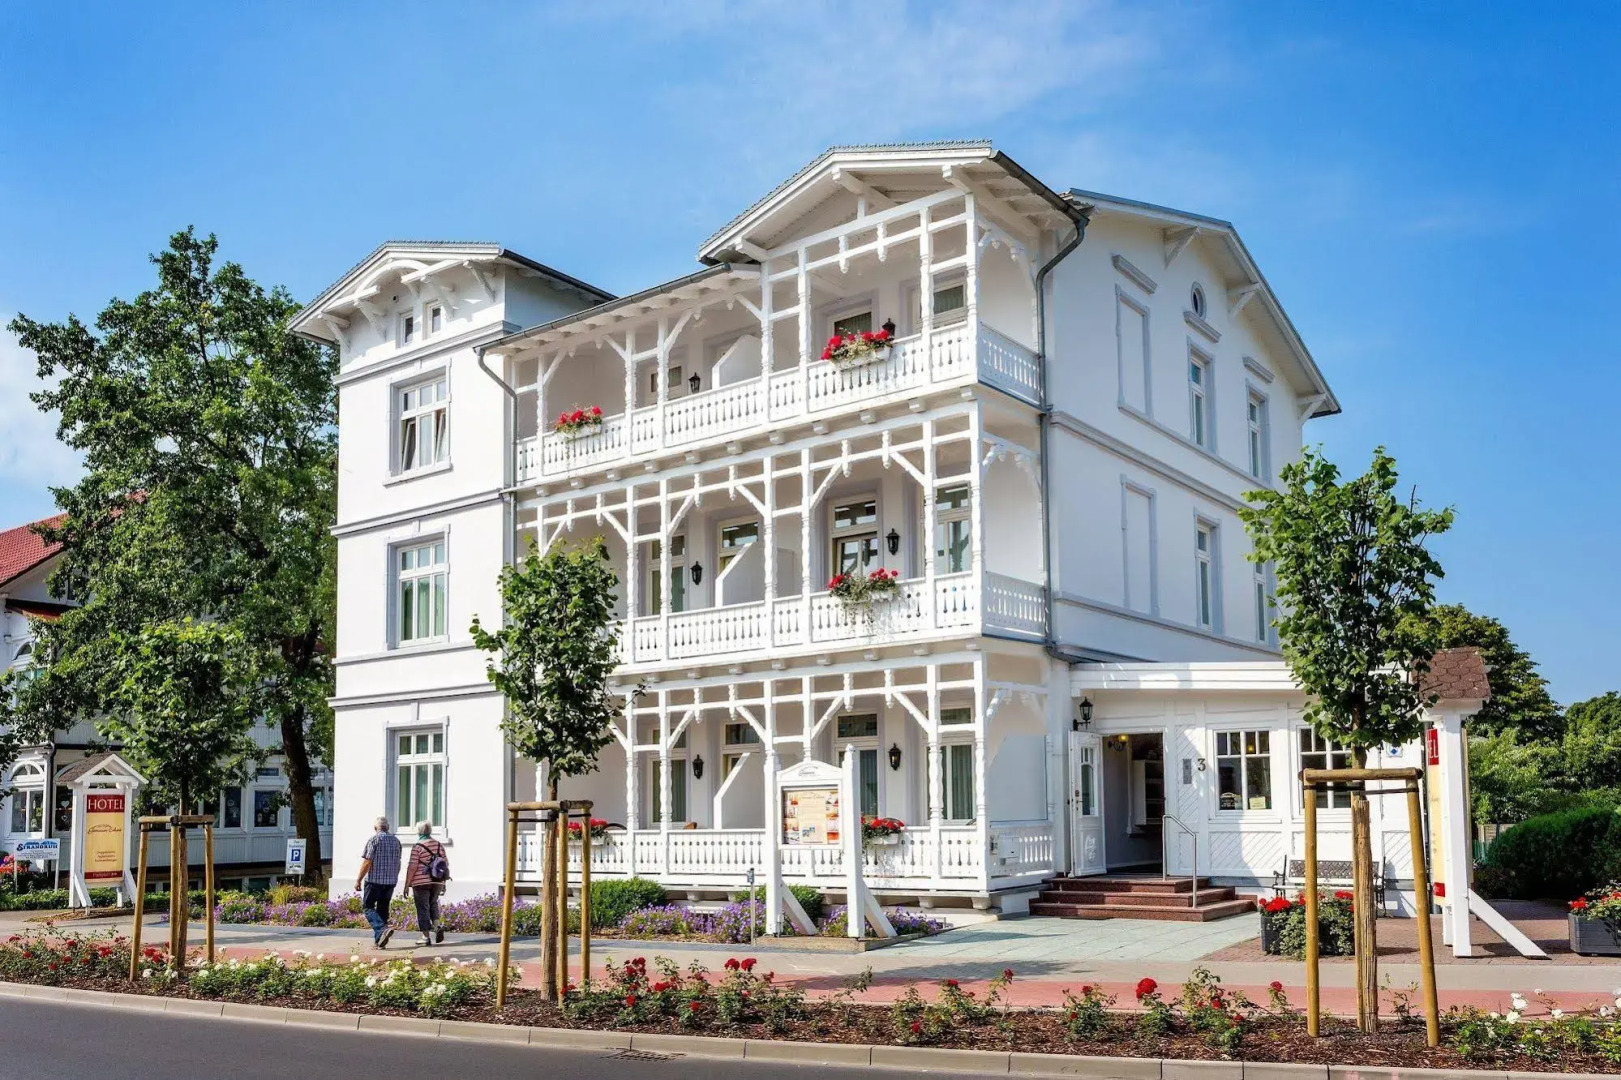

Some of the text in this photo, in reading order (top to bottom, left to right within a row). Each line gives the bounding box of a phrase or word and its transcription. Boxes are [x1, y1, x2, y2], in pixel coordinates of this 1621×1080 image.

[1197, 758, 1206, 772] 3
[88, 799, 124, 810] HOTEL
[293, 850, 300, 860] P
